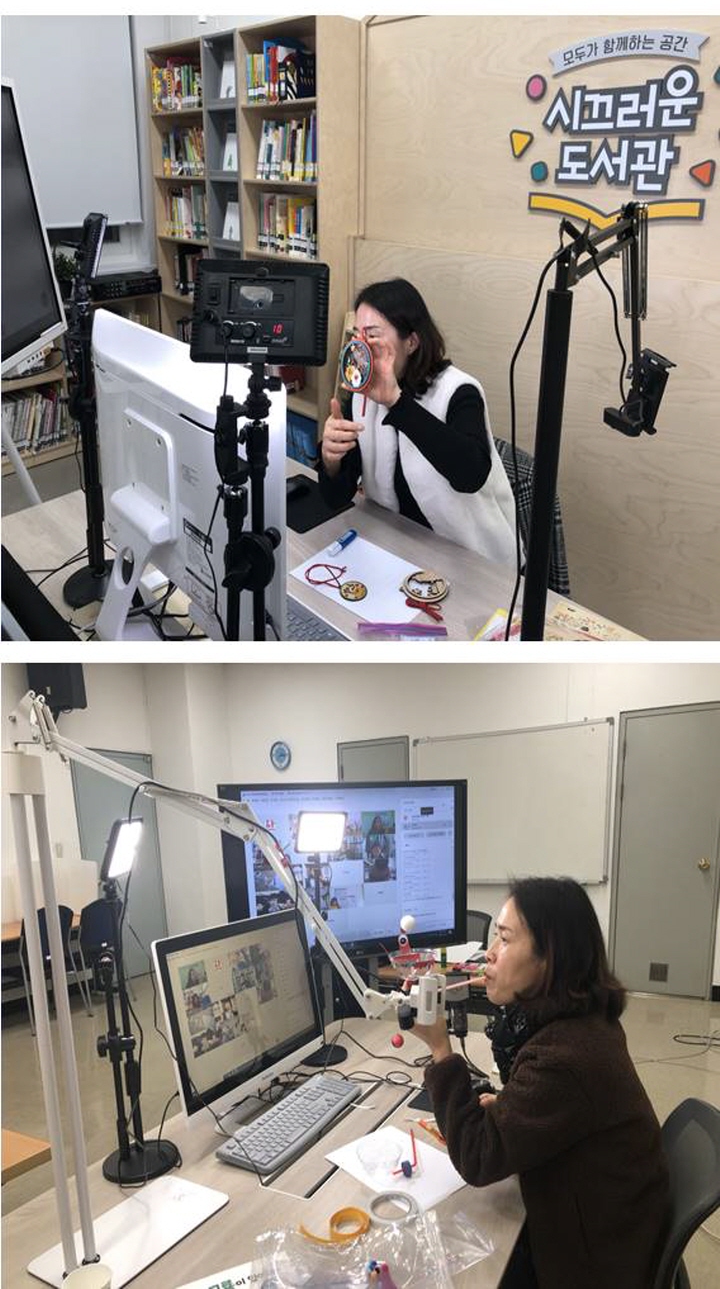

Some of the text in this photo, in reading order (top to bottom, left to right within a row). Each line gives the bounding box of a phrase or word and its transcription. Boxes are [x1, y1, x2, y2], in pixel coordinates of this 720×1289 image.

[563, 34, 688, 66] 모두가 함께하는 공간
[546, 69, 698, 131] 시끄러운
[558, 138, 675, 191] 도서관
